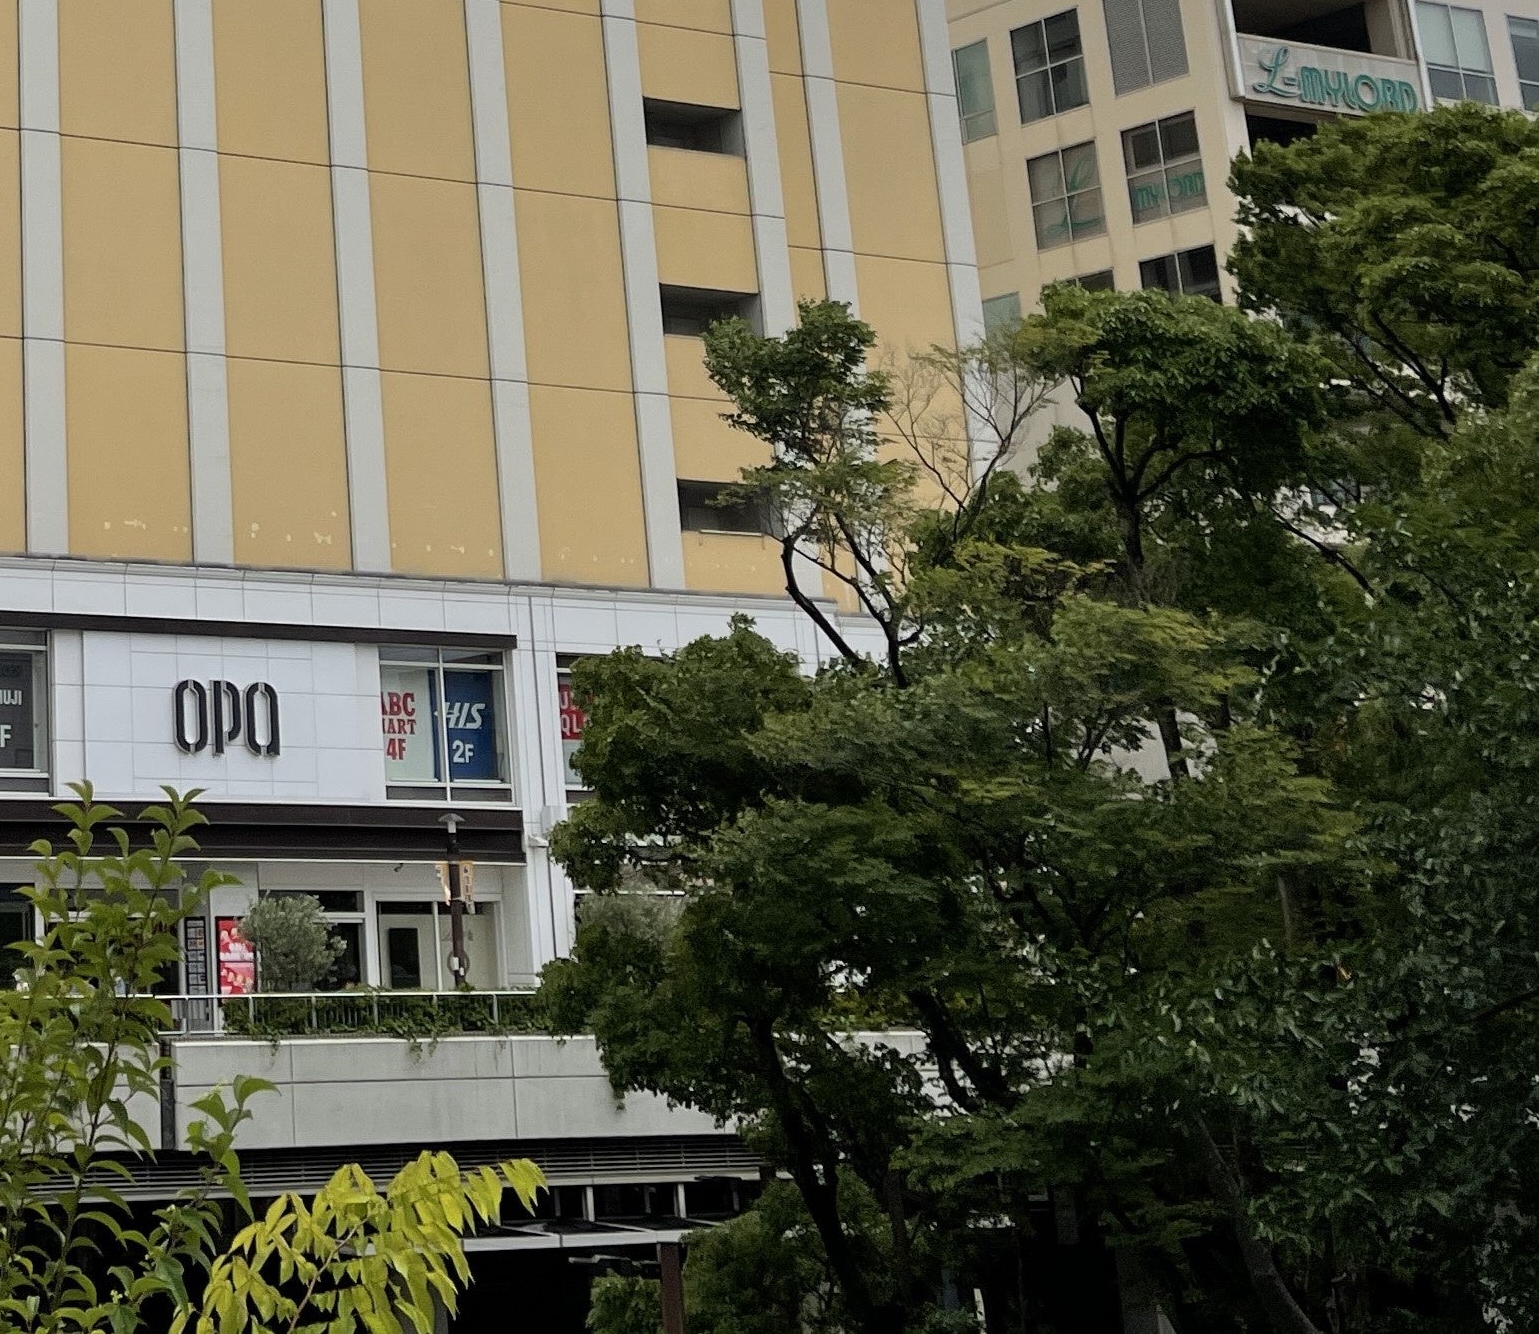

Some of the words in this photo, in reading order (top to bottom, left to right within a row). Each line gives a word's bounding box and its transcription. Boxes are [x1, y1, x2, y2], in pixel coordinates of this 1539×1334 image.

[382, 718, 417, 735] ART
[386, 738, 407, 760] 4F
[452, 740, 474, 763] 2F
